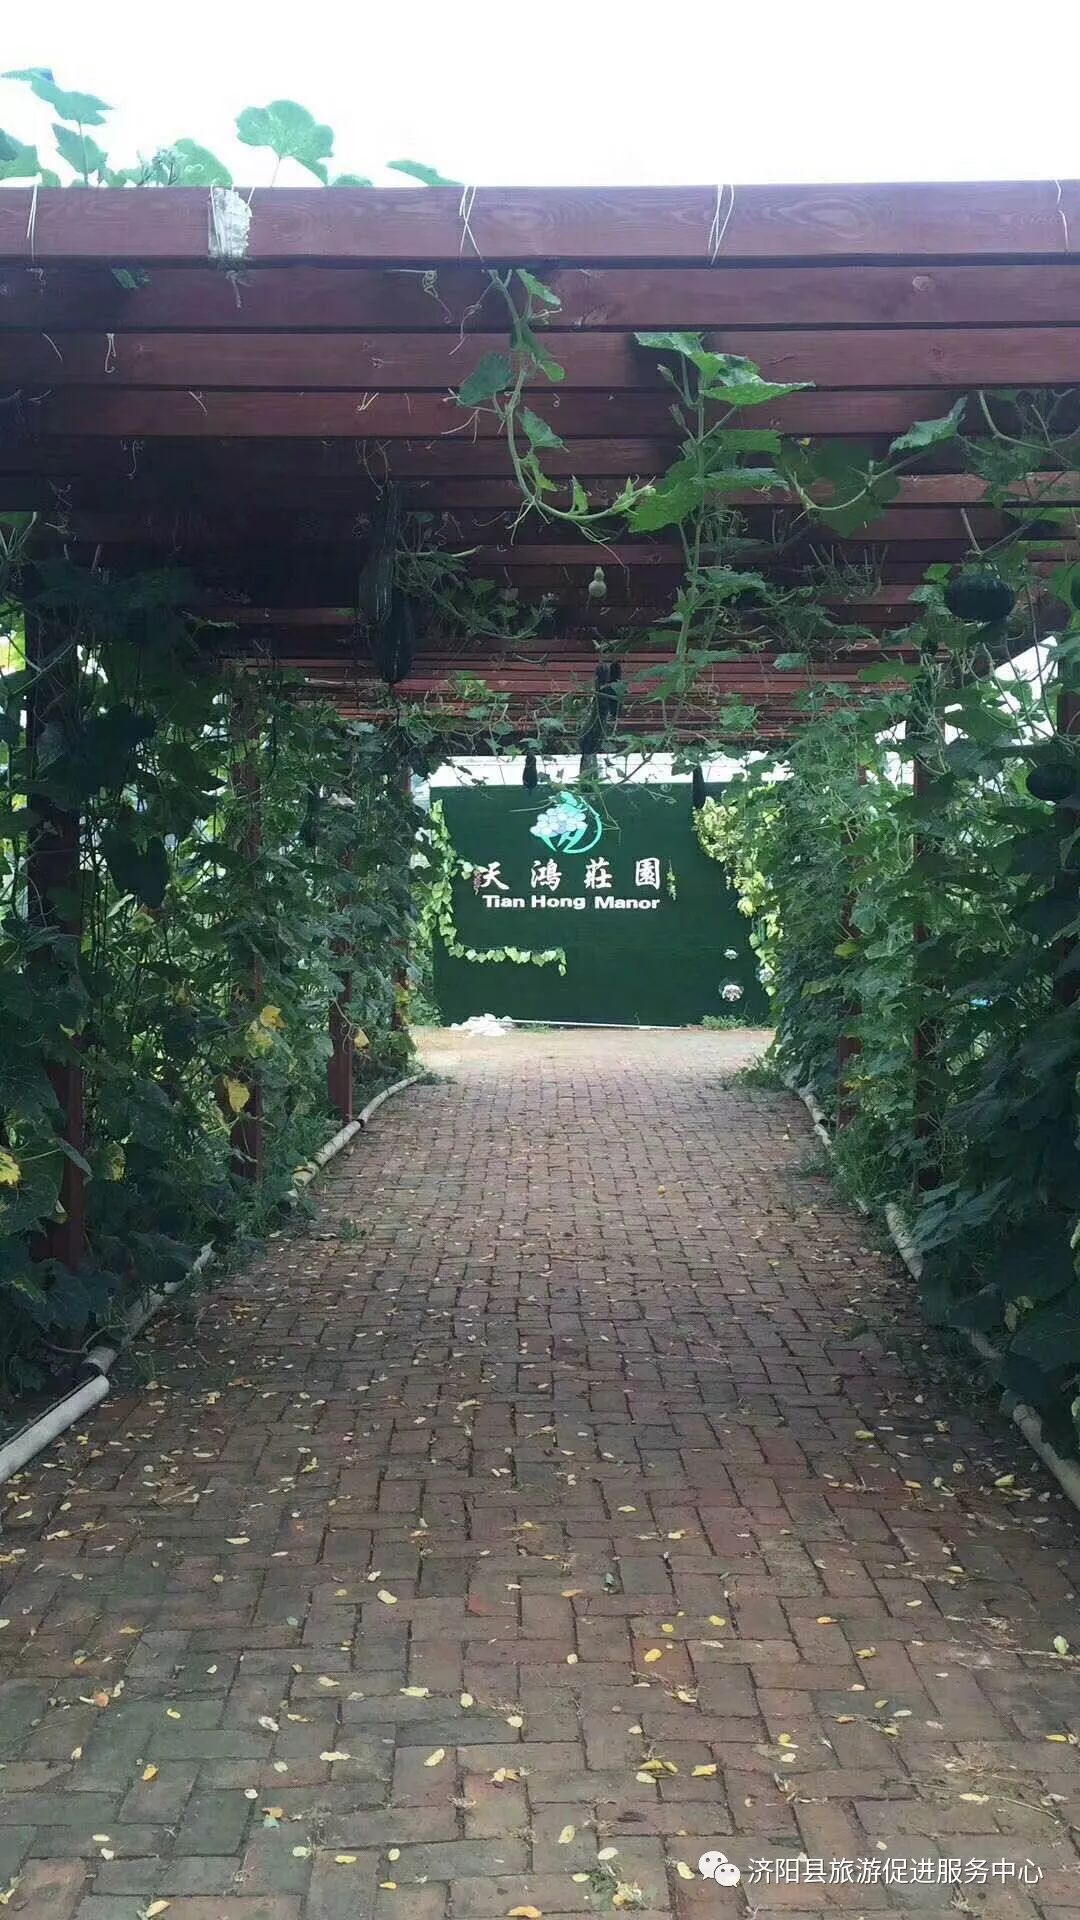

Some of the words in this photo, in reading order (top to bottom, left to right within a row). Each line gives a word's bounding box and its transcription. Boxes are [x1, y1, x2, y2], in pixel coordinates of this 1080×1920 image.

[482, 895, 525, 908] Tian
[531, 895, 586, 910] Hong
[595, 896, 660, 909] Manor
